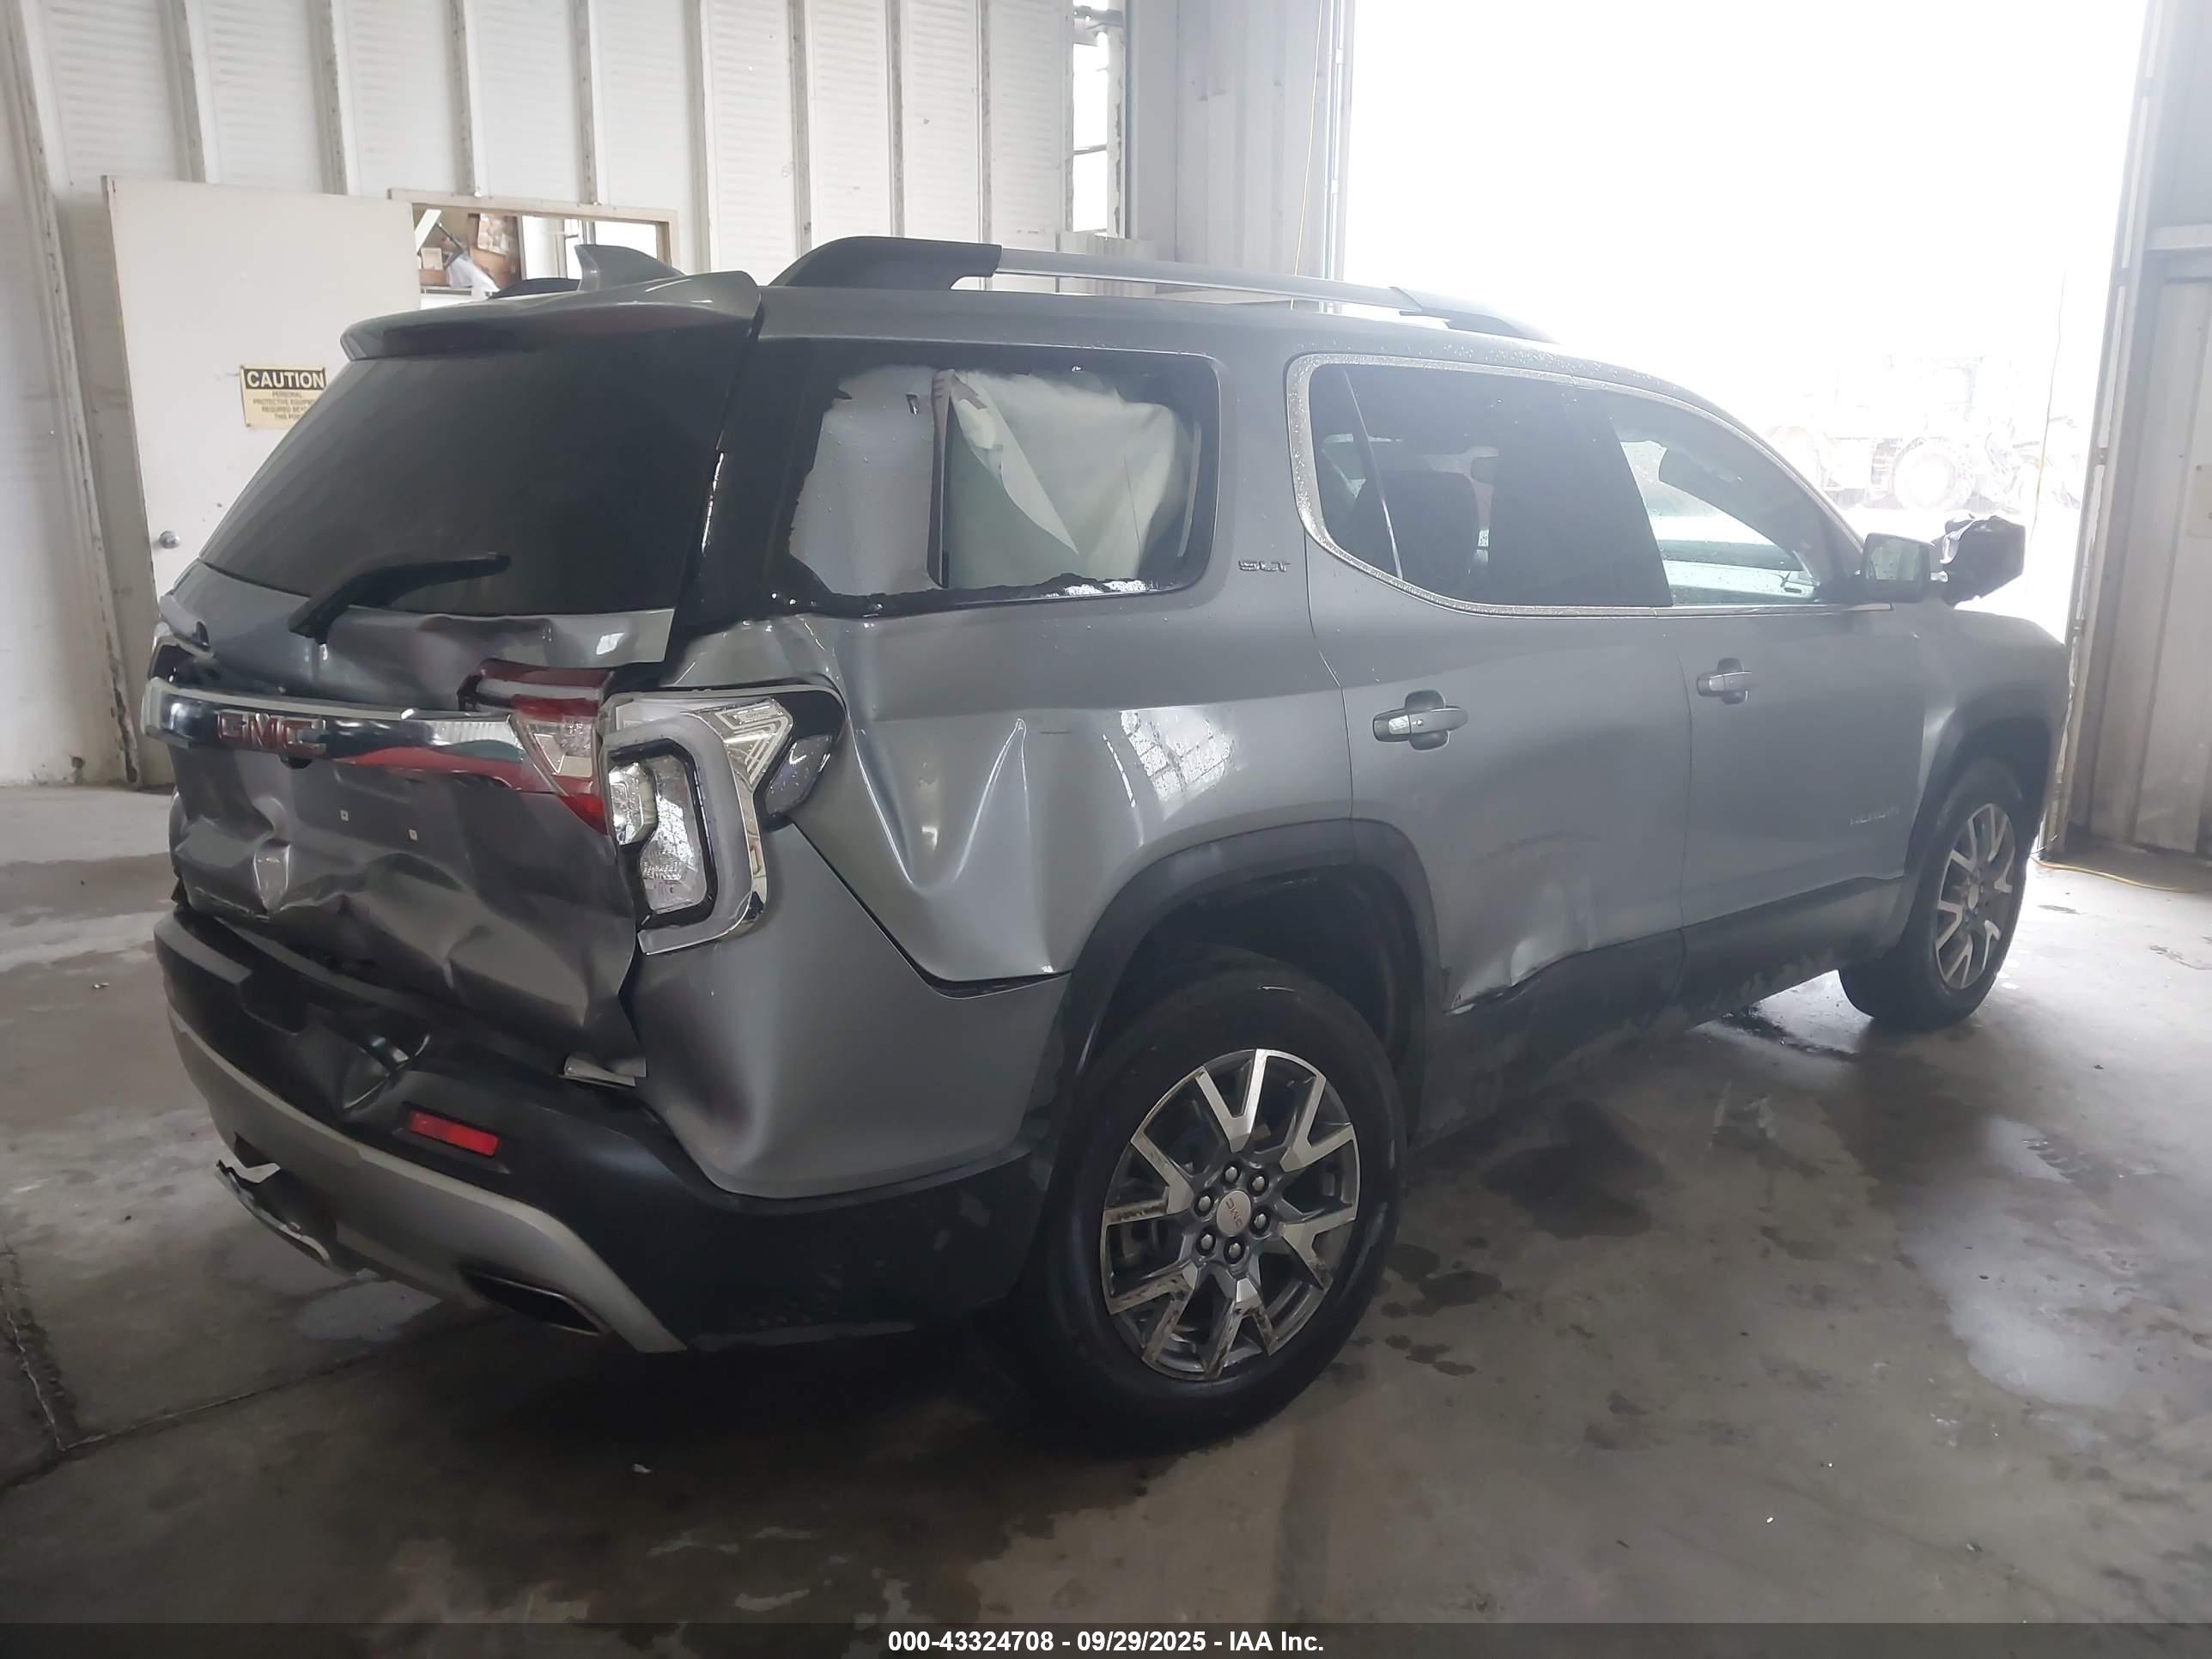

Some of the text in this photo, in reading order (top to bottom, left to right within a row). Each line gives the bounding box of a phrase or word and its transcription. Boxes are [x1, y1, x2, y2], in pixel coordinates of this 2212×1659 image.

[246, 371, 324, 388] CAUTION
[1238, 560, 1291, 573] SLT
[216, 710, 327, 757] GMC
[1225, 1197, 1243, 1229] GMC
